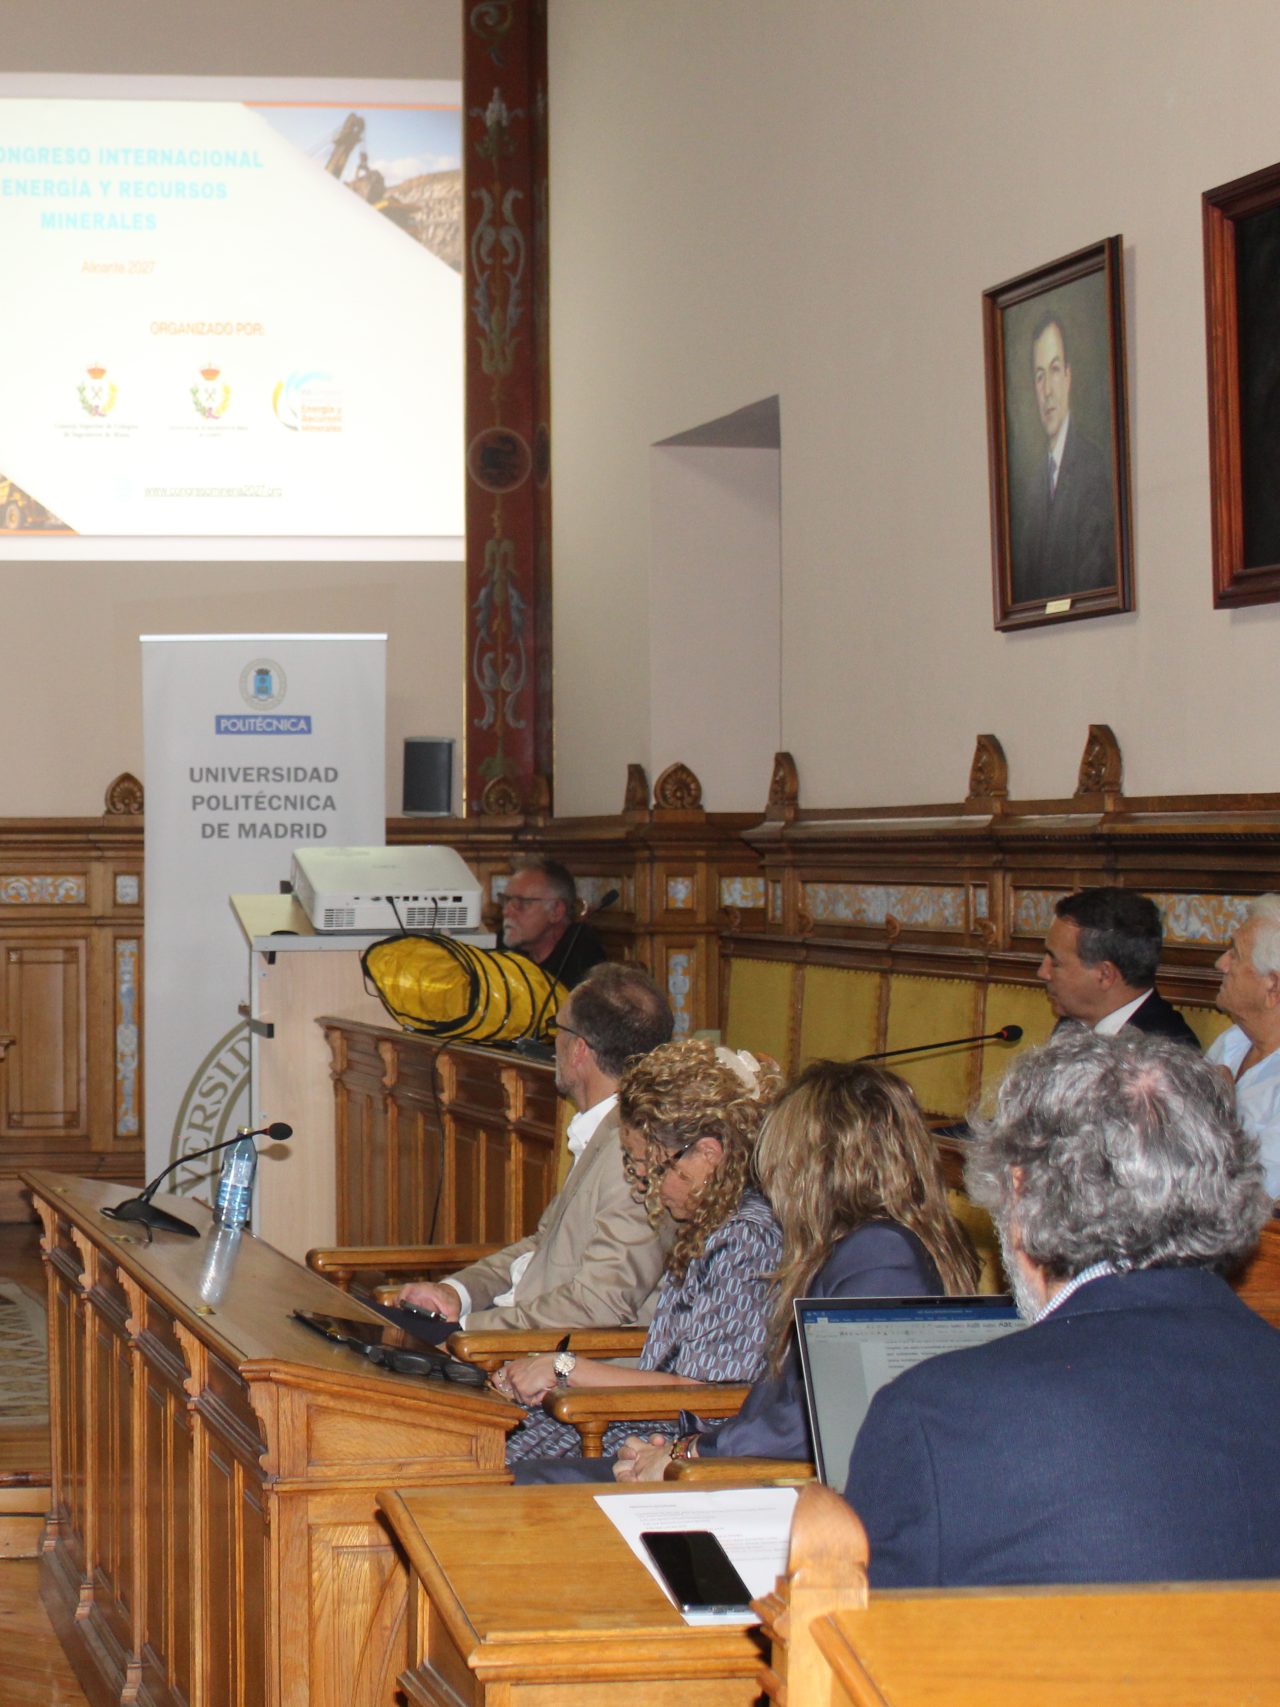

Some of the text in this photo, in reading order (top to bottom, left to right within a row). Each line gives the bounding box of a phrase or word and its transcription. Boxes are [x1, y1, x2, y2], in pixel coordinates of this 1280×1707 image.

[99, 146, 265, 168] INTERNACIONAL
[2, 175, 92, 198] ENERGÍA
[99, 179, 114, 198] Y
[119, 180, 228, 200] RECURSOS
[40, 210, 158, 231] MINERALES
[150, 322, 266, 336] ORGANIZADO POR:
[219, 715, 308, 732] POLITÉCNICA
[189, 766, 339, 784] UNIVERSIDAD
[191, 790, 337, 811] POLITÉCNICA
[201, 823, 328, 839] DE MADRID
